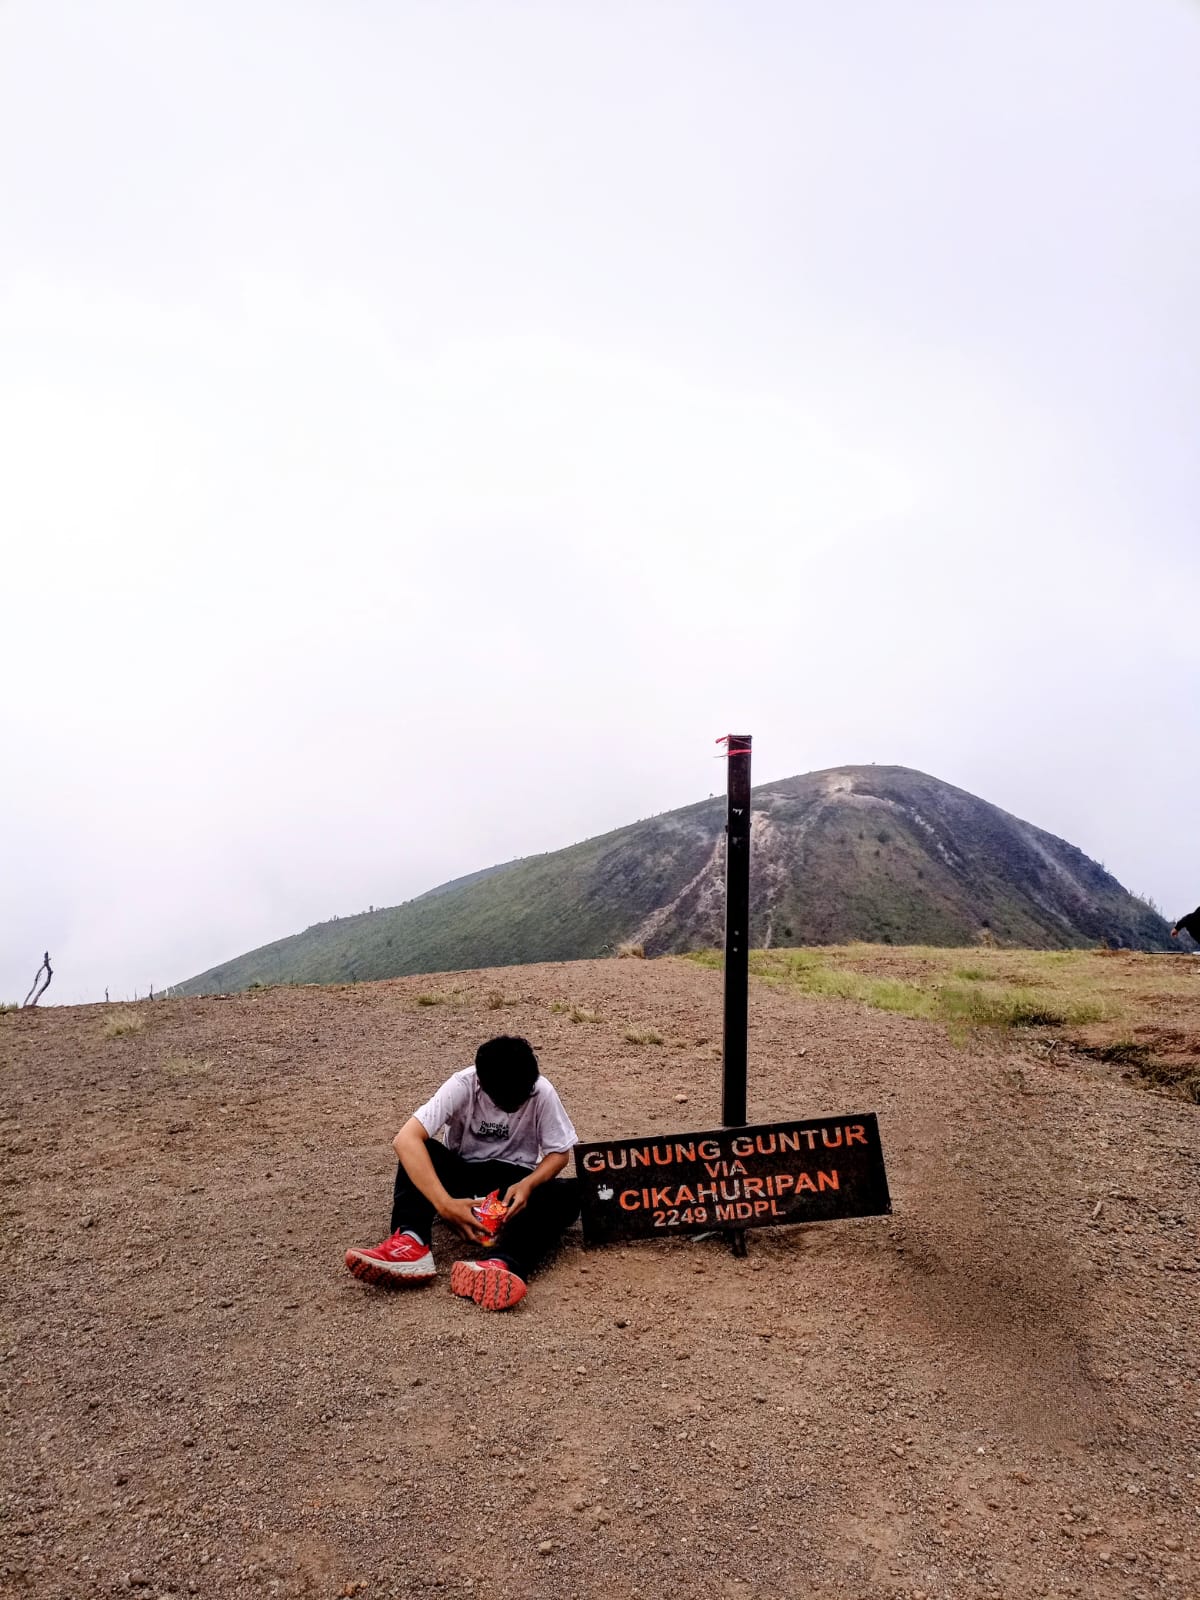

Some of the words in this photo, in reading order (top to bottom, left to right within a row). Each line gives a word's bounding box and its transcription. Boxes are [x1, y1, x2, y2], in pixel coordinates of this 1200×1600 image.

[583, 1140, 721, 1172] GUNUNG
[731, 1125, 868, 1157] GUNTUR
[704, 1160, 748, 1178] VIA
[619, 1170, 839, 1210] CIKAHURIPAN
[653, 1207, 708, 1227] 2249
[716, 1200, 786, 1221] MDPL
